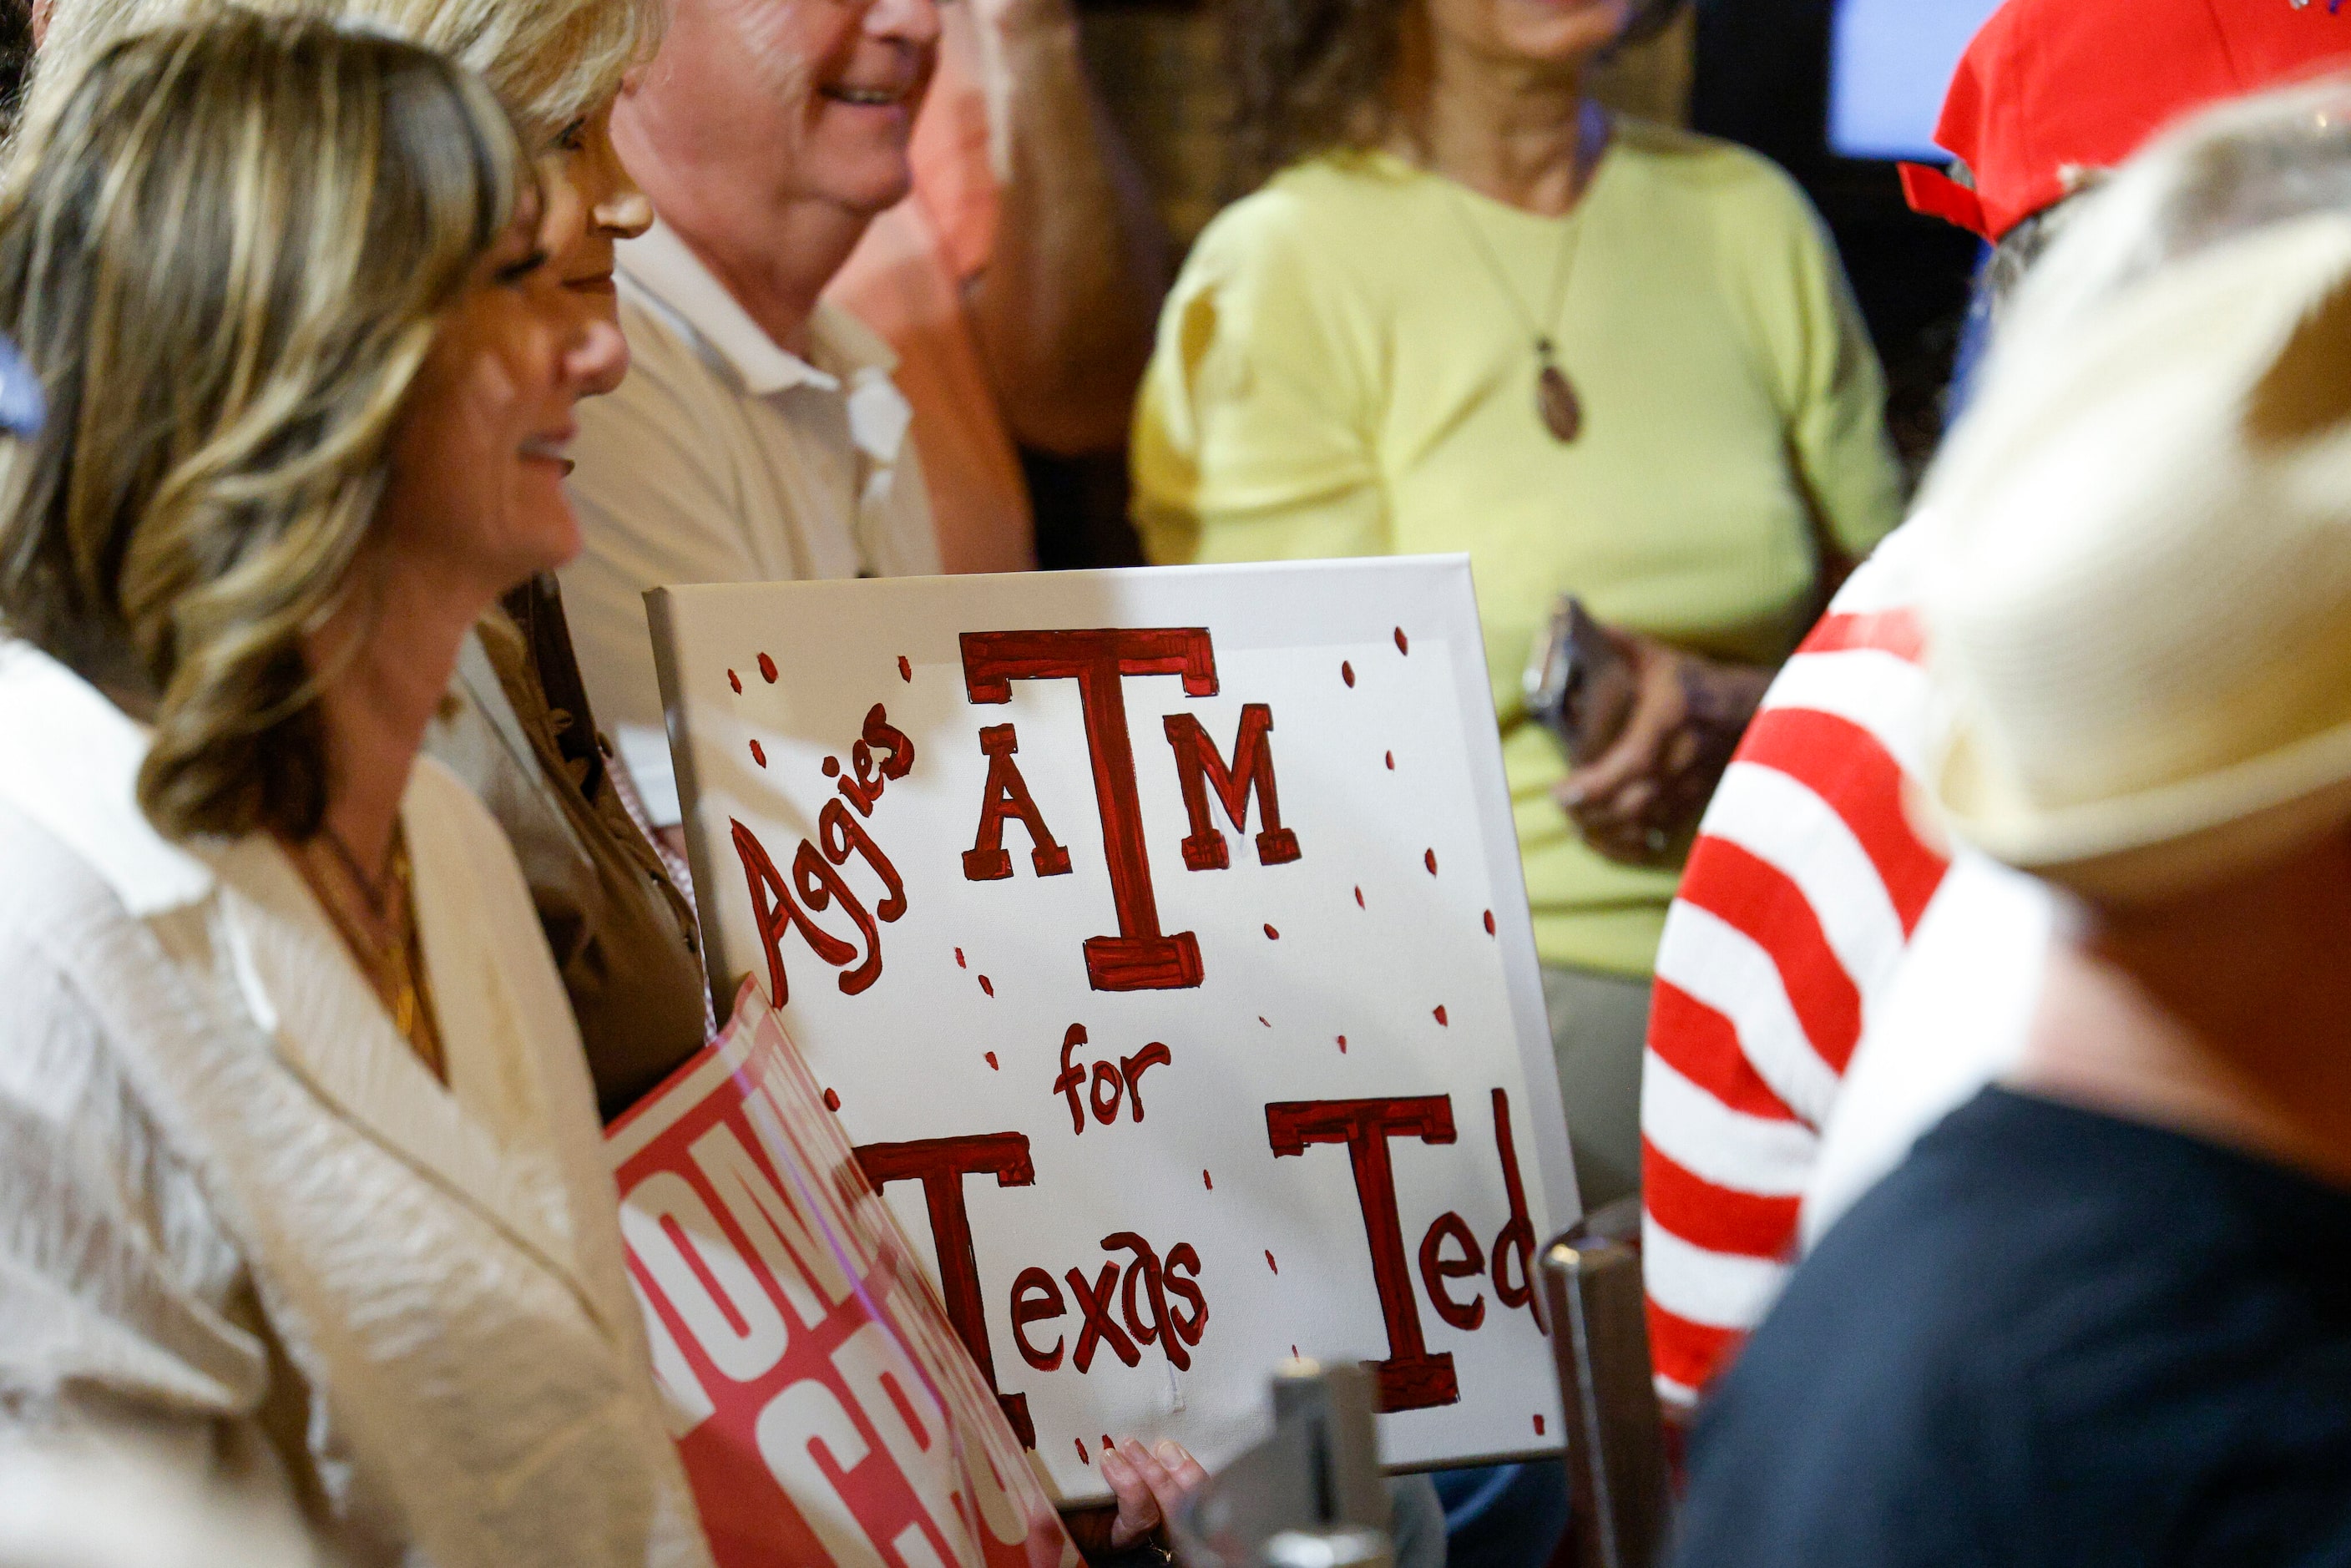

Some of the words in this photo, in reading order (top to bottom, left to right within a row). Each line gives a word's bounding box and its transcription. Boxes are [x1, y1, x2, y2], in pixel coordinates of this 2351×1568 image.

[730, 702, 916, 1009] Aggies
[1054, 1024, 1170, 1135] for
[851, 1131, 1208, 1450] Texas
[1265, 1087, 1550, 1413] Ted
